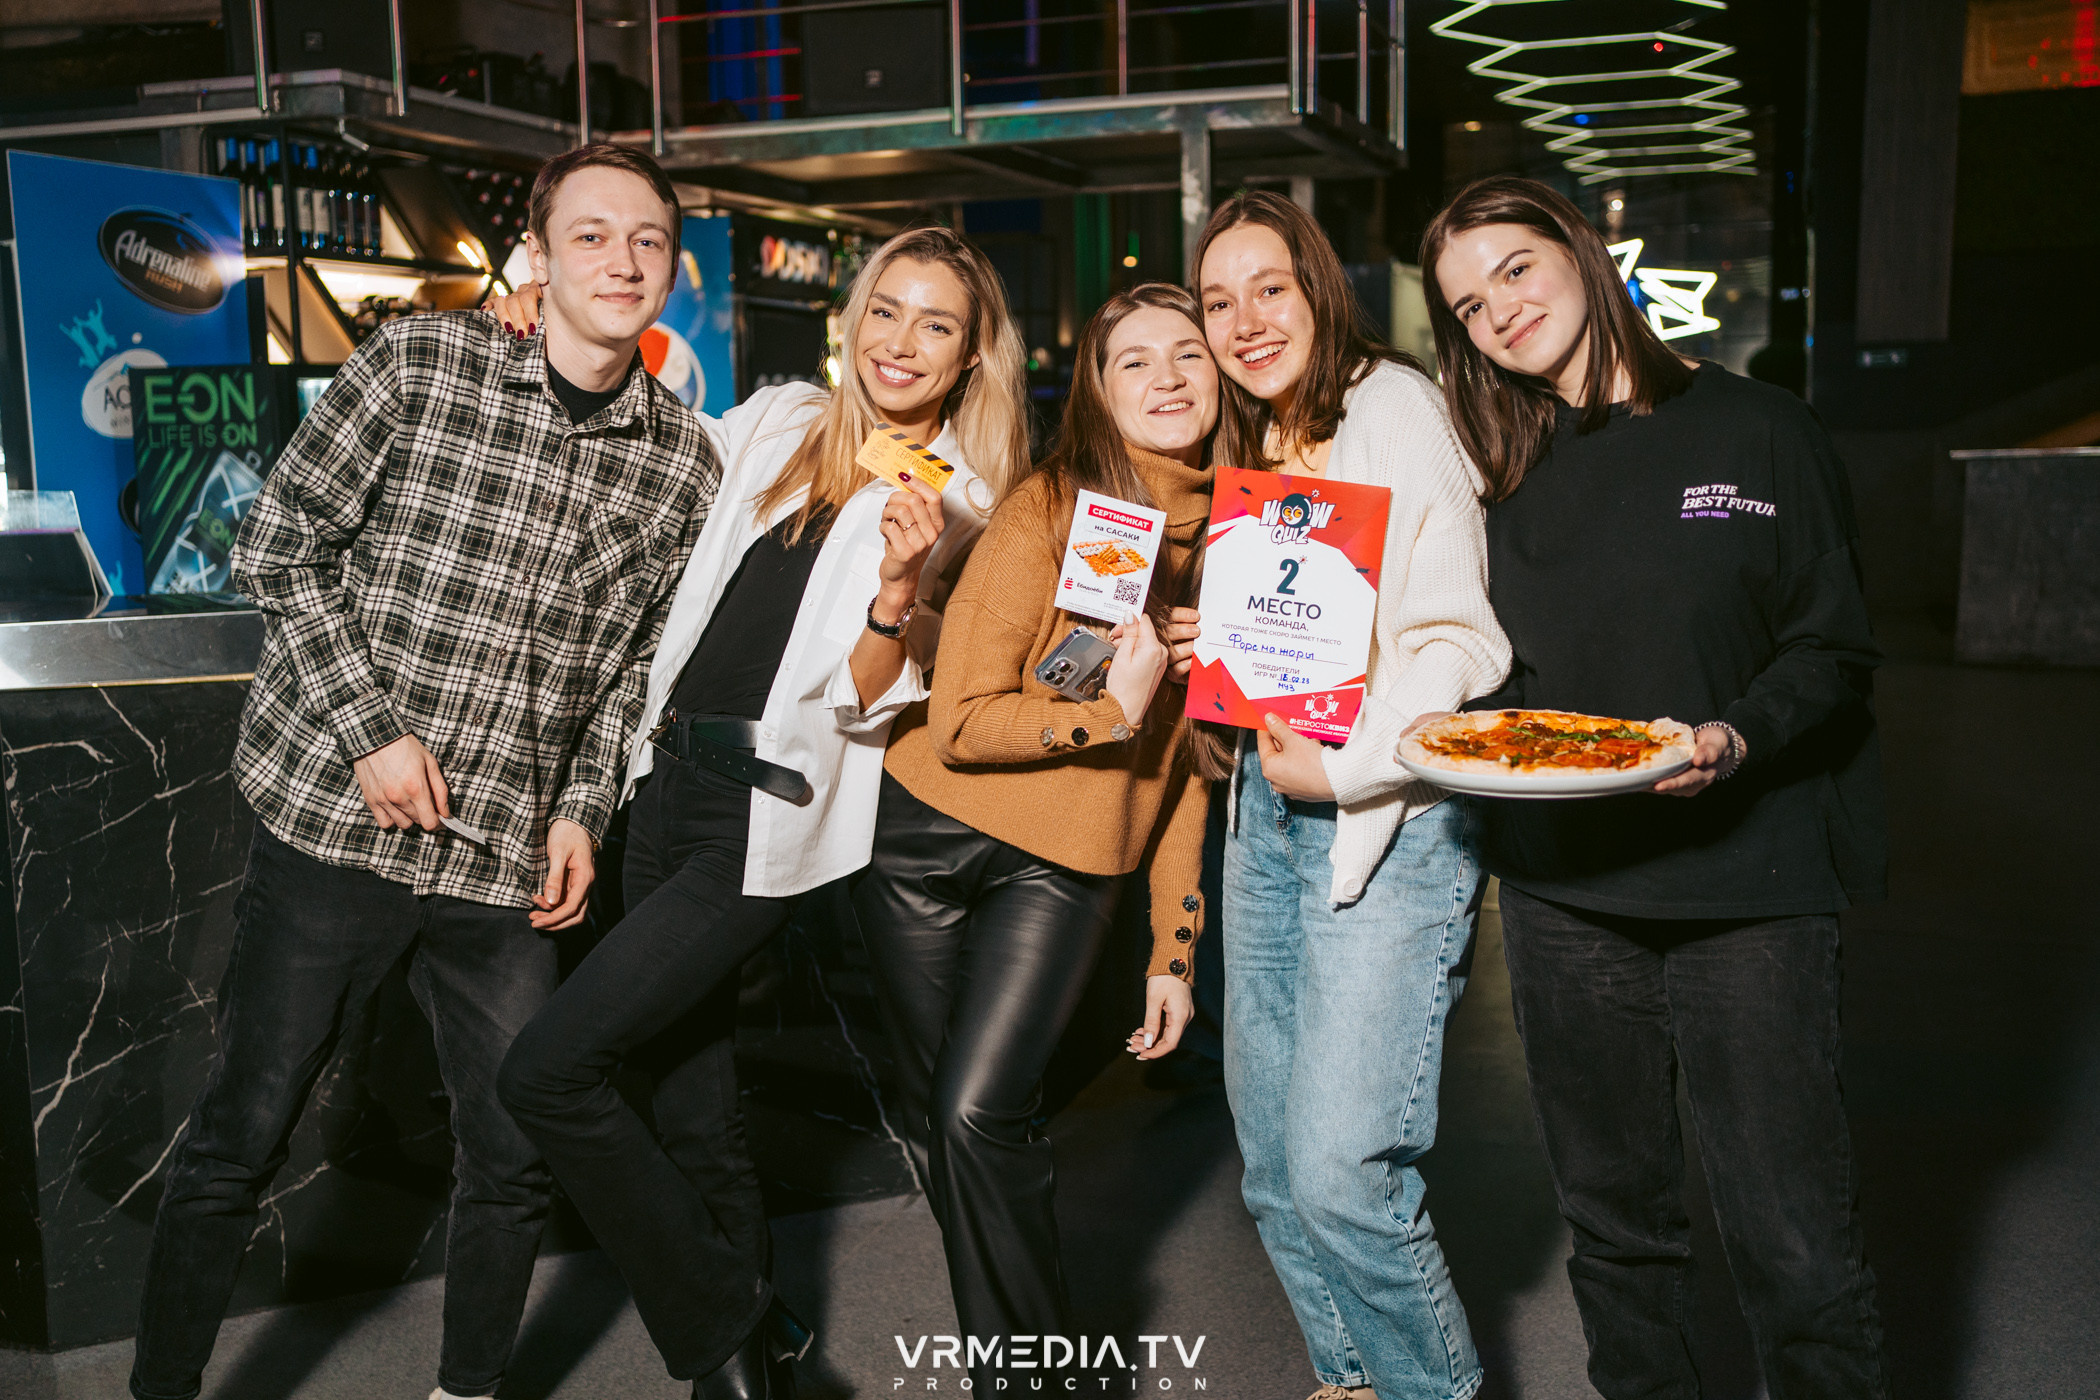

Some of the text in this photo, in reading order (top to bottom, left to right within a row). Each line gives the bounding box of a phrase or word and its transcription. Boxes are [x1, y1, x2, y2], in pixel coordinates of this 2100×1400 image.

[115, 230, 211, 293] Adrenaline
[148, 422, 258, 449] LIFE IS ON
[895, 447, 942, 481] СЕРТИФИКАТ
[1683, 484, 1738, 497] FOR THE
[1259, 493, 1336, 528] WOW
[1681, 496, 1727, 510] BEST
[1092, 507, 1150, 529] СЕРТИФИКАТ
[1094, 524, 1140, 542] на САСАКИ
[1271, 524, 1311, 545] QUIZ
[1276, 558, 1299, 595] 2
[1247, 595, 1322, 620] МЕСТО
[1221, 623, 1250, 632] КОТОРАЯ
[1250, 627, 1269, 635] ТОЖЕ
[1269, 629, 1290, 638] СКОРО
[1320, 637, 1342, 646] МЕСТО
[1255, 615, 1309, 632] КОМАНДА,
[1252, 662, 1300, 675] ПОБЕДИТЕЛИ
